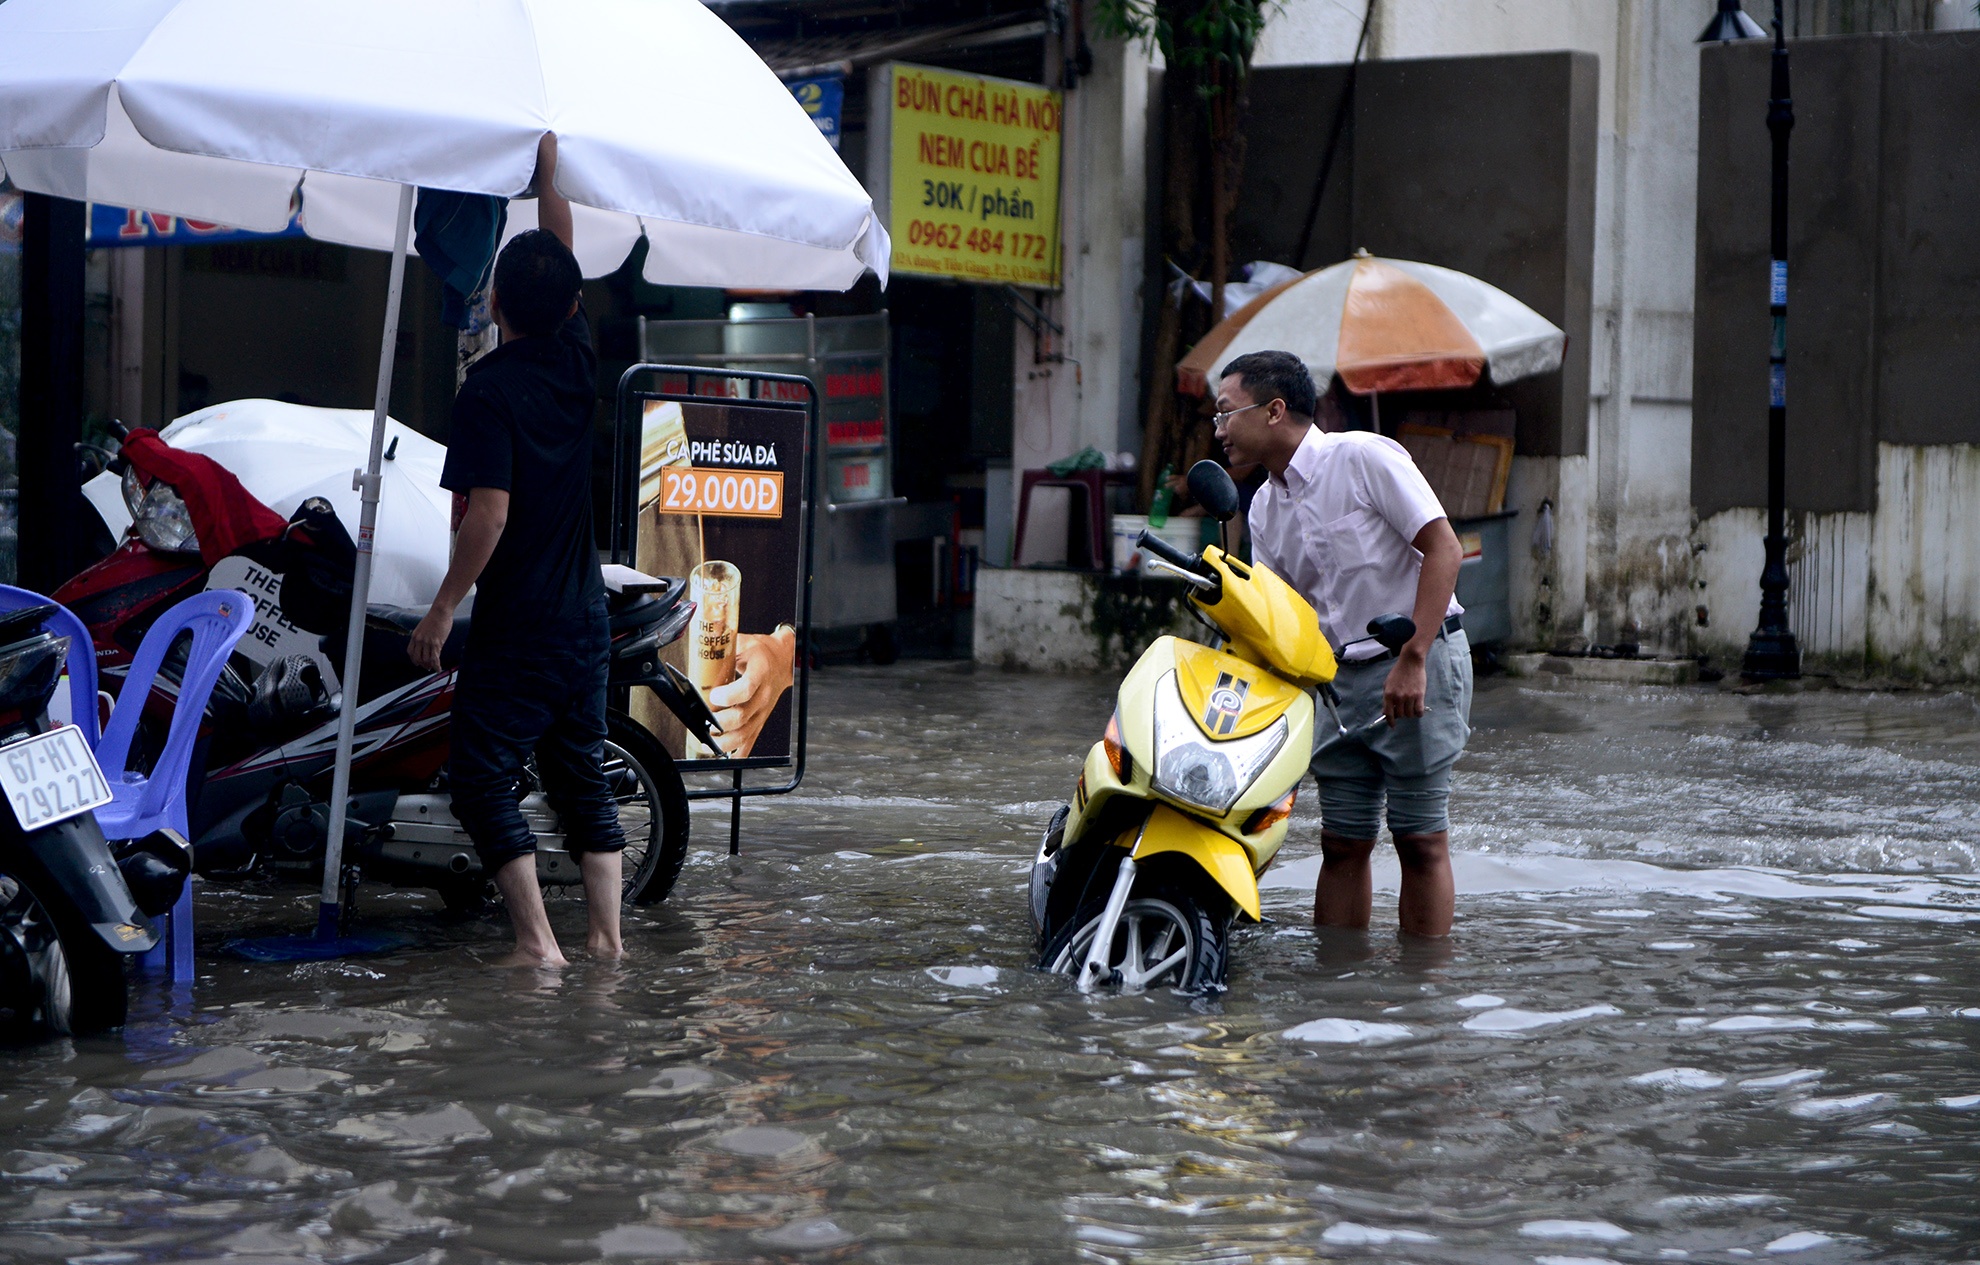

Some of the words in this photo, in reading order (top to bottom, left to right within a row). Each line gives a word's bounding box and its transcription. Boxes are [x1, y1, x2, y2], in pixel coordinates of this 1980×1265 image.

[897, 72, 941, 114] BÚN
[947, 79, 988, 121] CHẢ
[992, 89, 1021, 127] HÀ
[919, 131, 965, 170] NEM
[970, 140, 1010, 176] CUA
[923, 179, 964, 210] 30K
[982, 187, 1034, 220] phần
[909, 219, 961, 250] 0962
[966, 227, 1005, 253] 484
[1011, 232, 1047, 261] 172
[666, 437, 689, 460] CÀ
[691, 438, 721, 462] PHÊ
[723, 439, 753, 464] SỮA
[755, 442, 777, 466] ĐÁ
[665, 473, 778, 511] 29.000Đ
[244, 565, 282, 595] THE
[245, 621, 281, 648] USE
[698, 632, 731, 646] COFFEE
[699, 620, 714, 633] THE
[95, 649, 119, 657] NDA
[16, 767, 99, 825] 292.27
